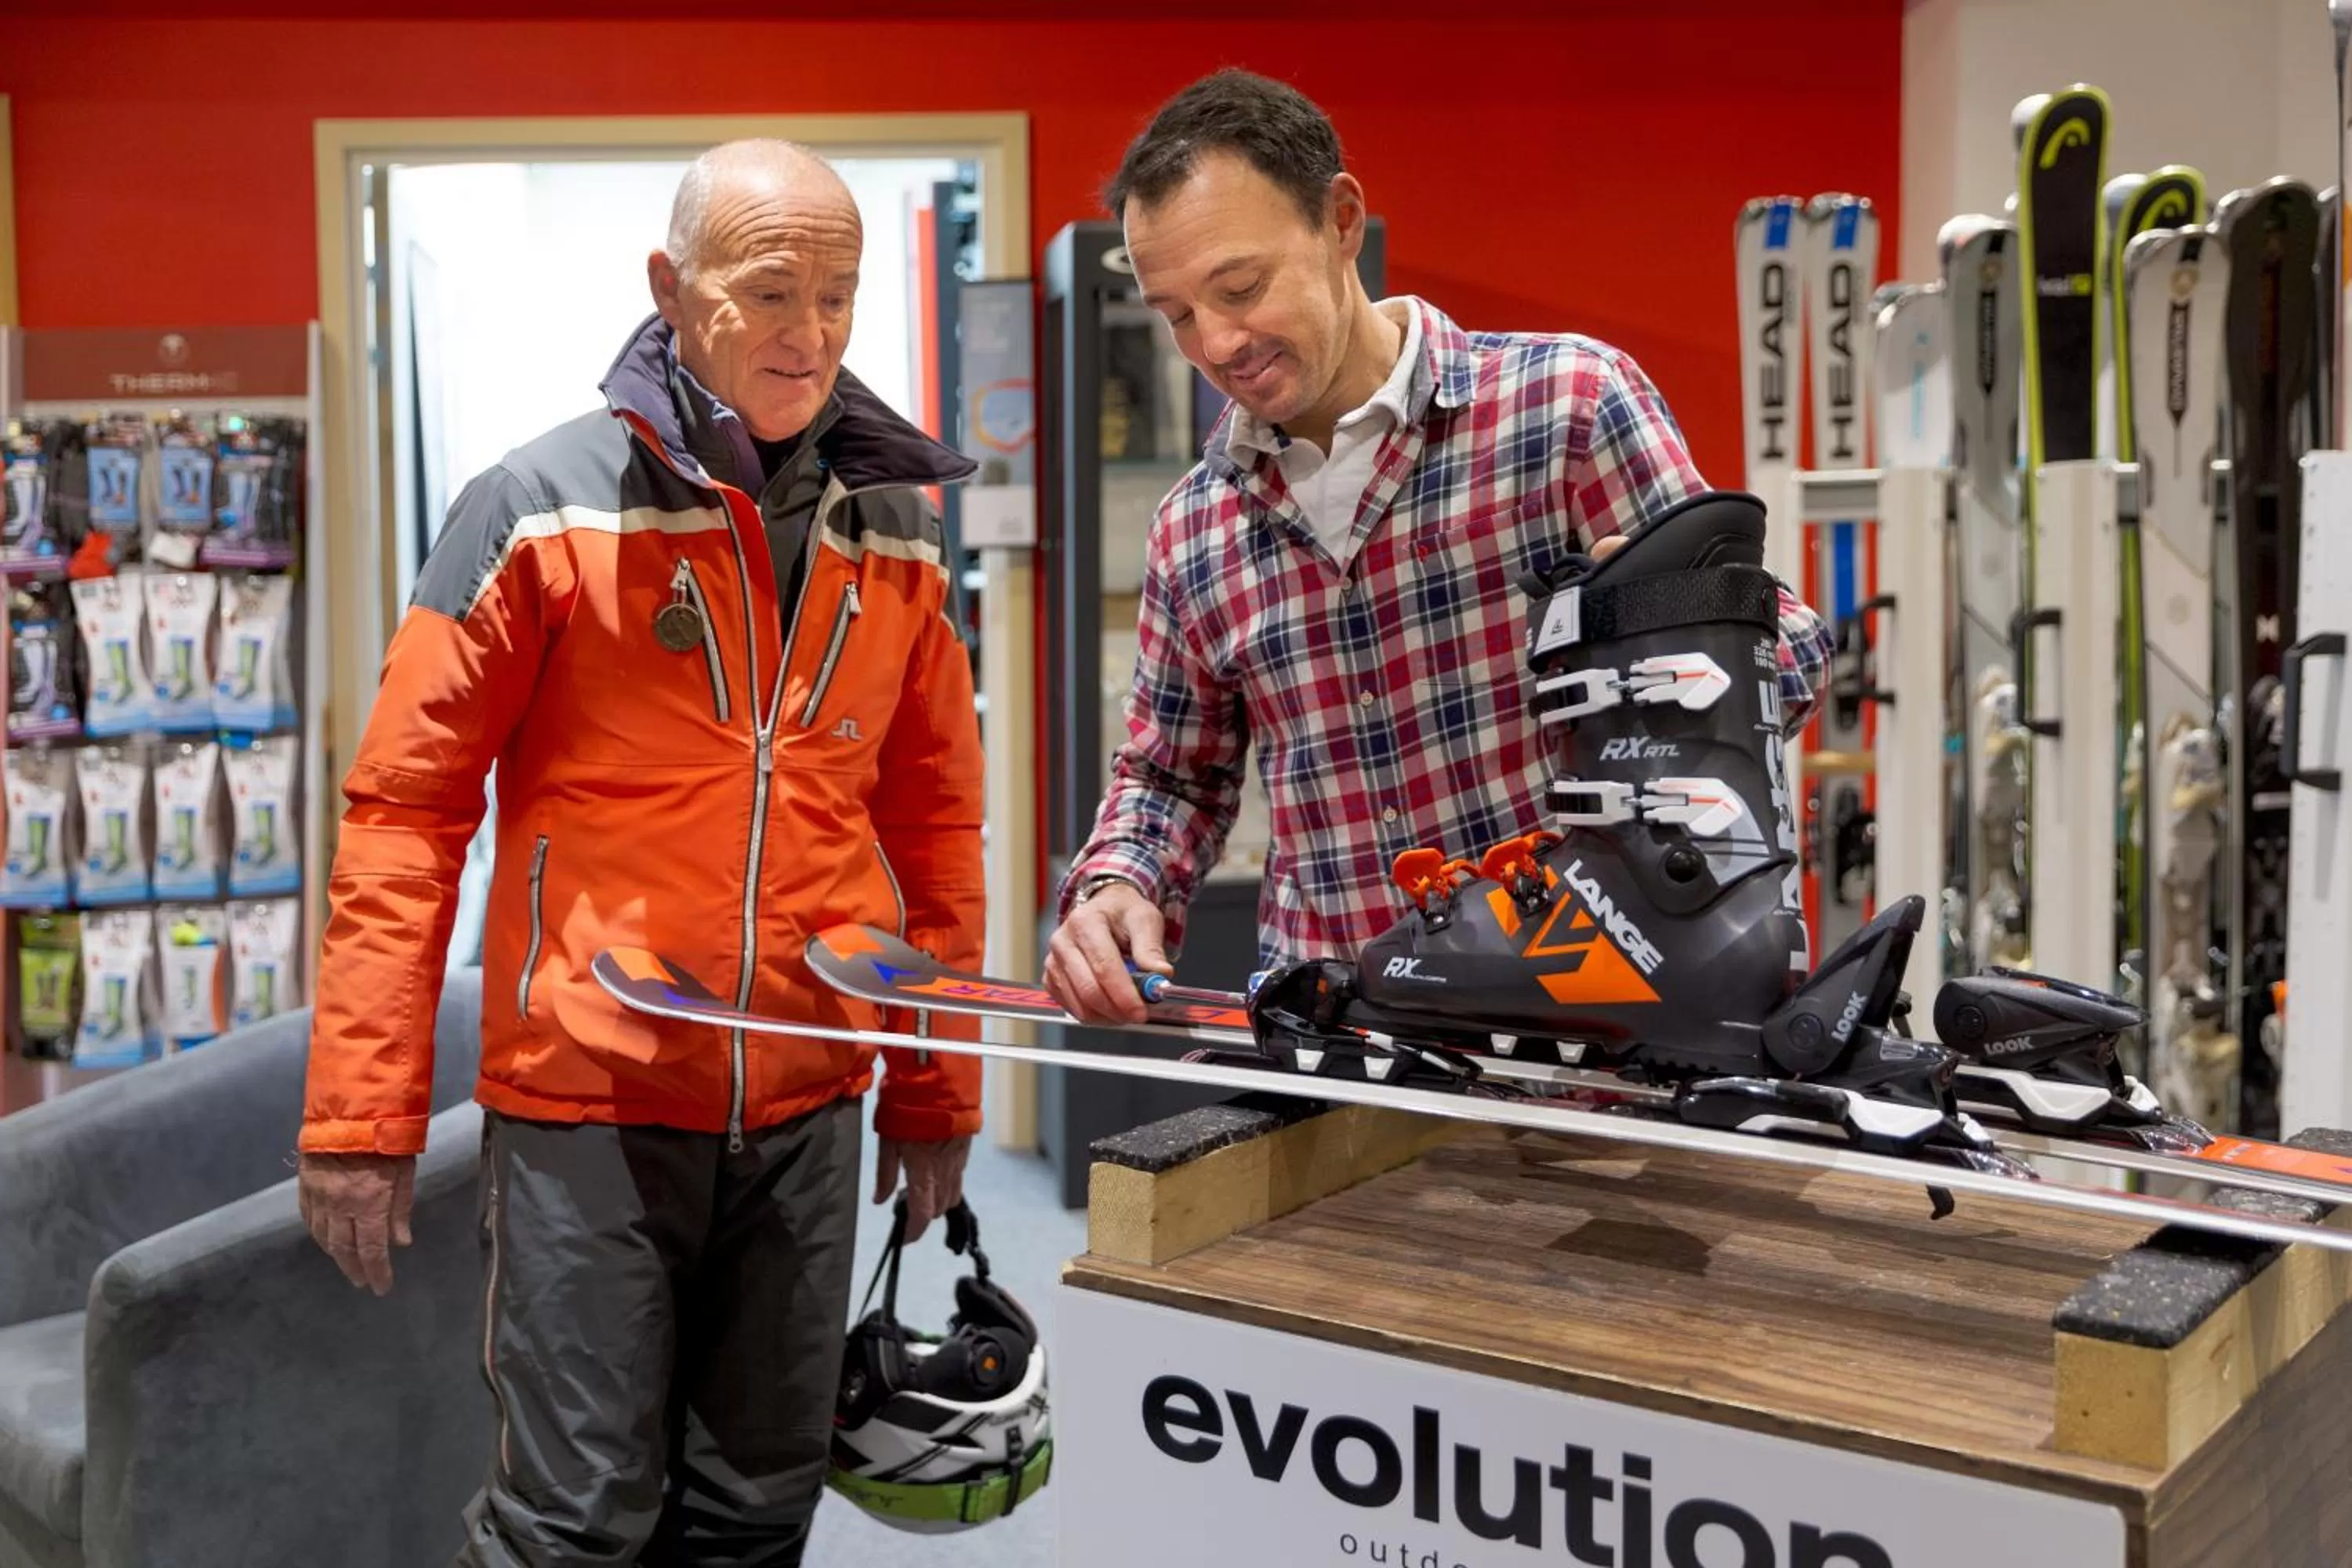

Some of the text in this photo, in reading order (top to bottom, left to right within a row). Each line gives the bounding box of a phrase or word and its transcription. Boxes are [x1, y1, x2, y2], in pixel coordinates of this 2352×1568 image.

[1761, 263, 1785, 459] HEAD
[1829, 261, 1853, 459] HEAD
[1599, 735, 1680, 760] RX RTL
[1563, 858, 1664, 975] LANGE
[1382, 956, 1422, 978] RX
[1831, 991, 1867, 1043] LOOK
[1984, 1036, 2034, 1056] LOOK
[1141, 1374, 1895, 1568] evolution
[1340, 1534, 1468, 1568] outd
